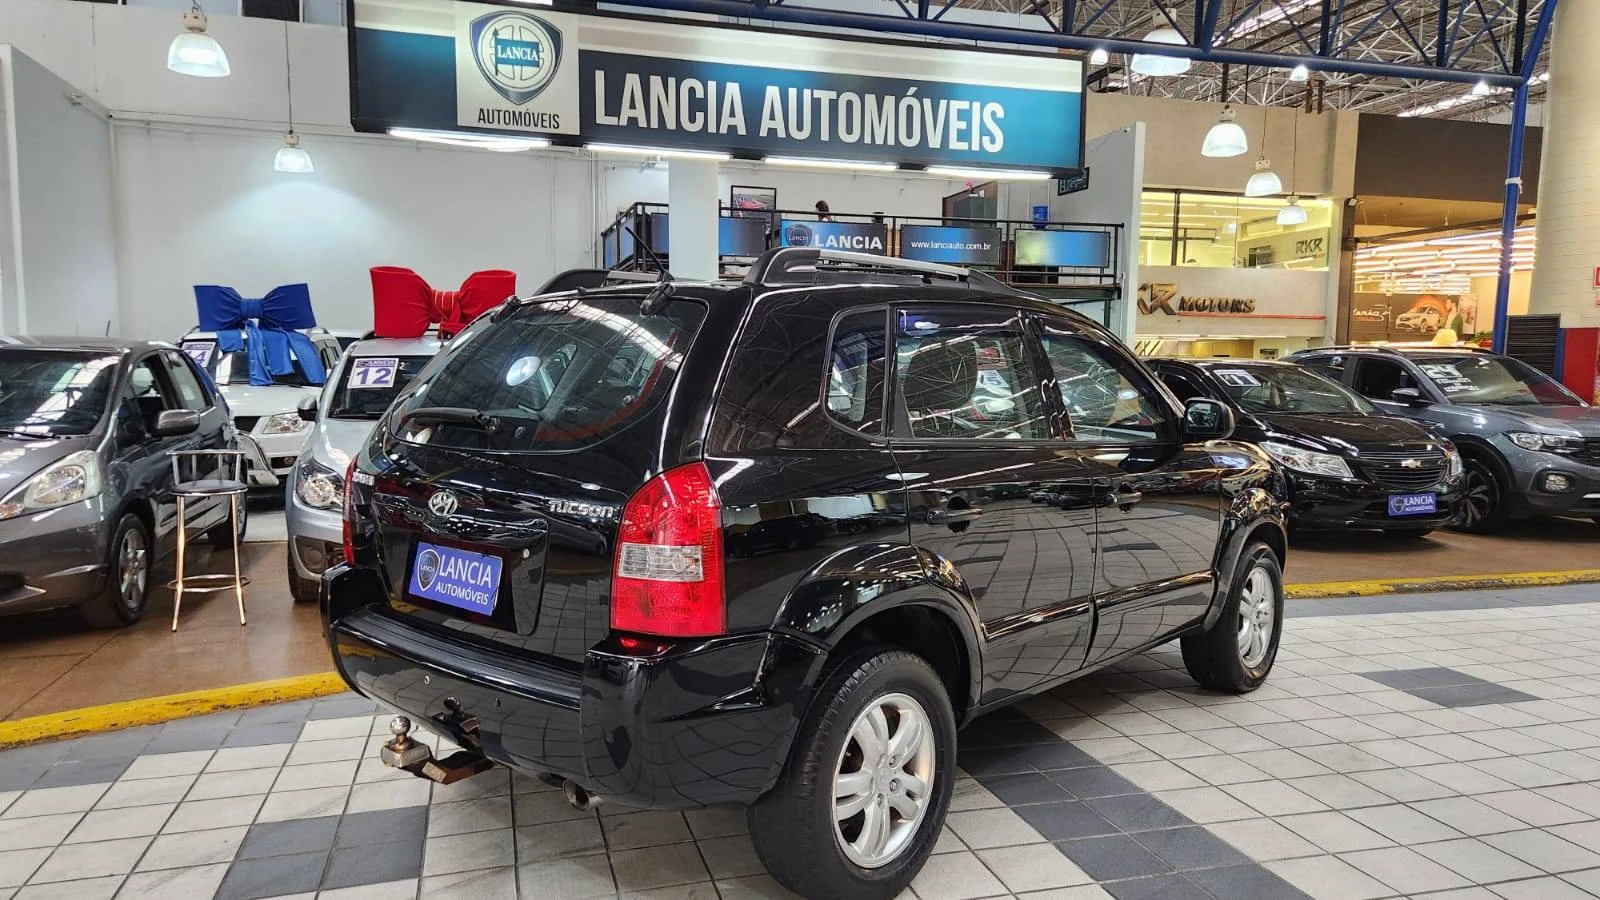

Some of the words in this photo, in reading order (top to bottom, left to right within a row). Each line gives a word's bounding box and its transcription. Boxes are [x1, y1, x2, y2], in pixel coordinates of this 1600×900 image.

[497, 44, 539, 61] LANCIA
[477, 107, 561, 129] AUTOMÓVEIS
[594, 69, 747, 136] LANCIA
[759, 86, 1006, 153] AUTOMÓVEIS
[814, 233, 884, 250] LANCIA
[910, 239, 992, 251] www.lanciauto.com.br
[1178, 296, 1256, 314] MOTORS
[356, 367, 392, 385] 12
[548, 499, 614, 518] TUCSON
[1404, 495, 1434, 506] LANCIA
[438, 554, 492, 589] LANCIA
[434, 581, 490, 606] AUTOMÓVEIS
